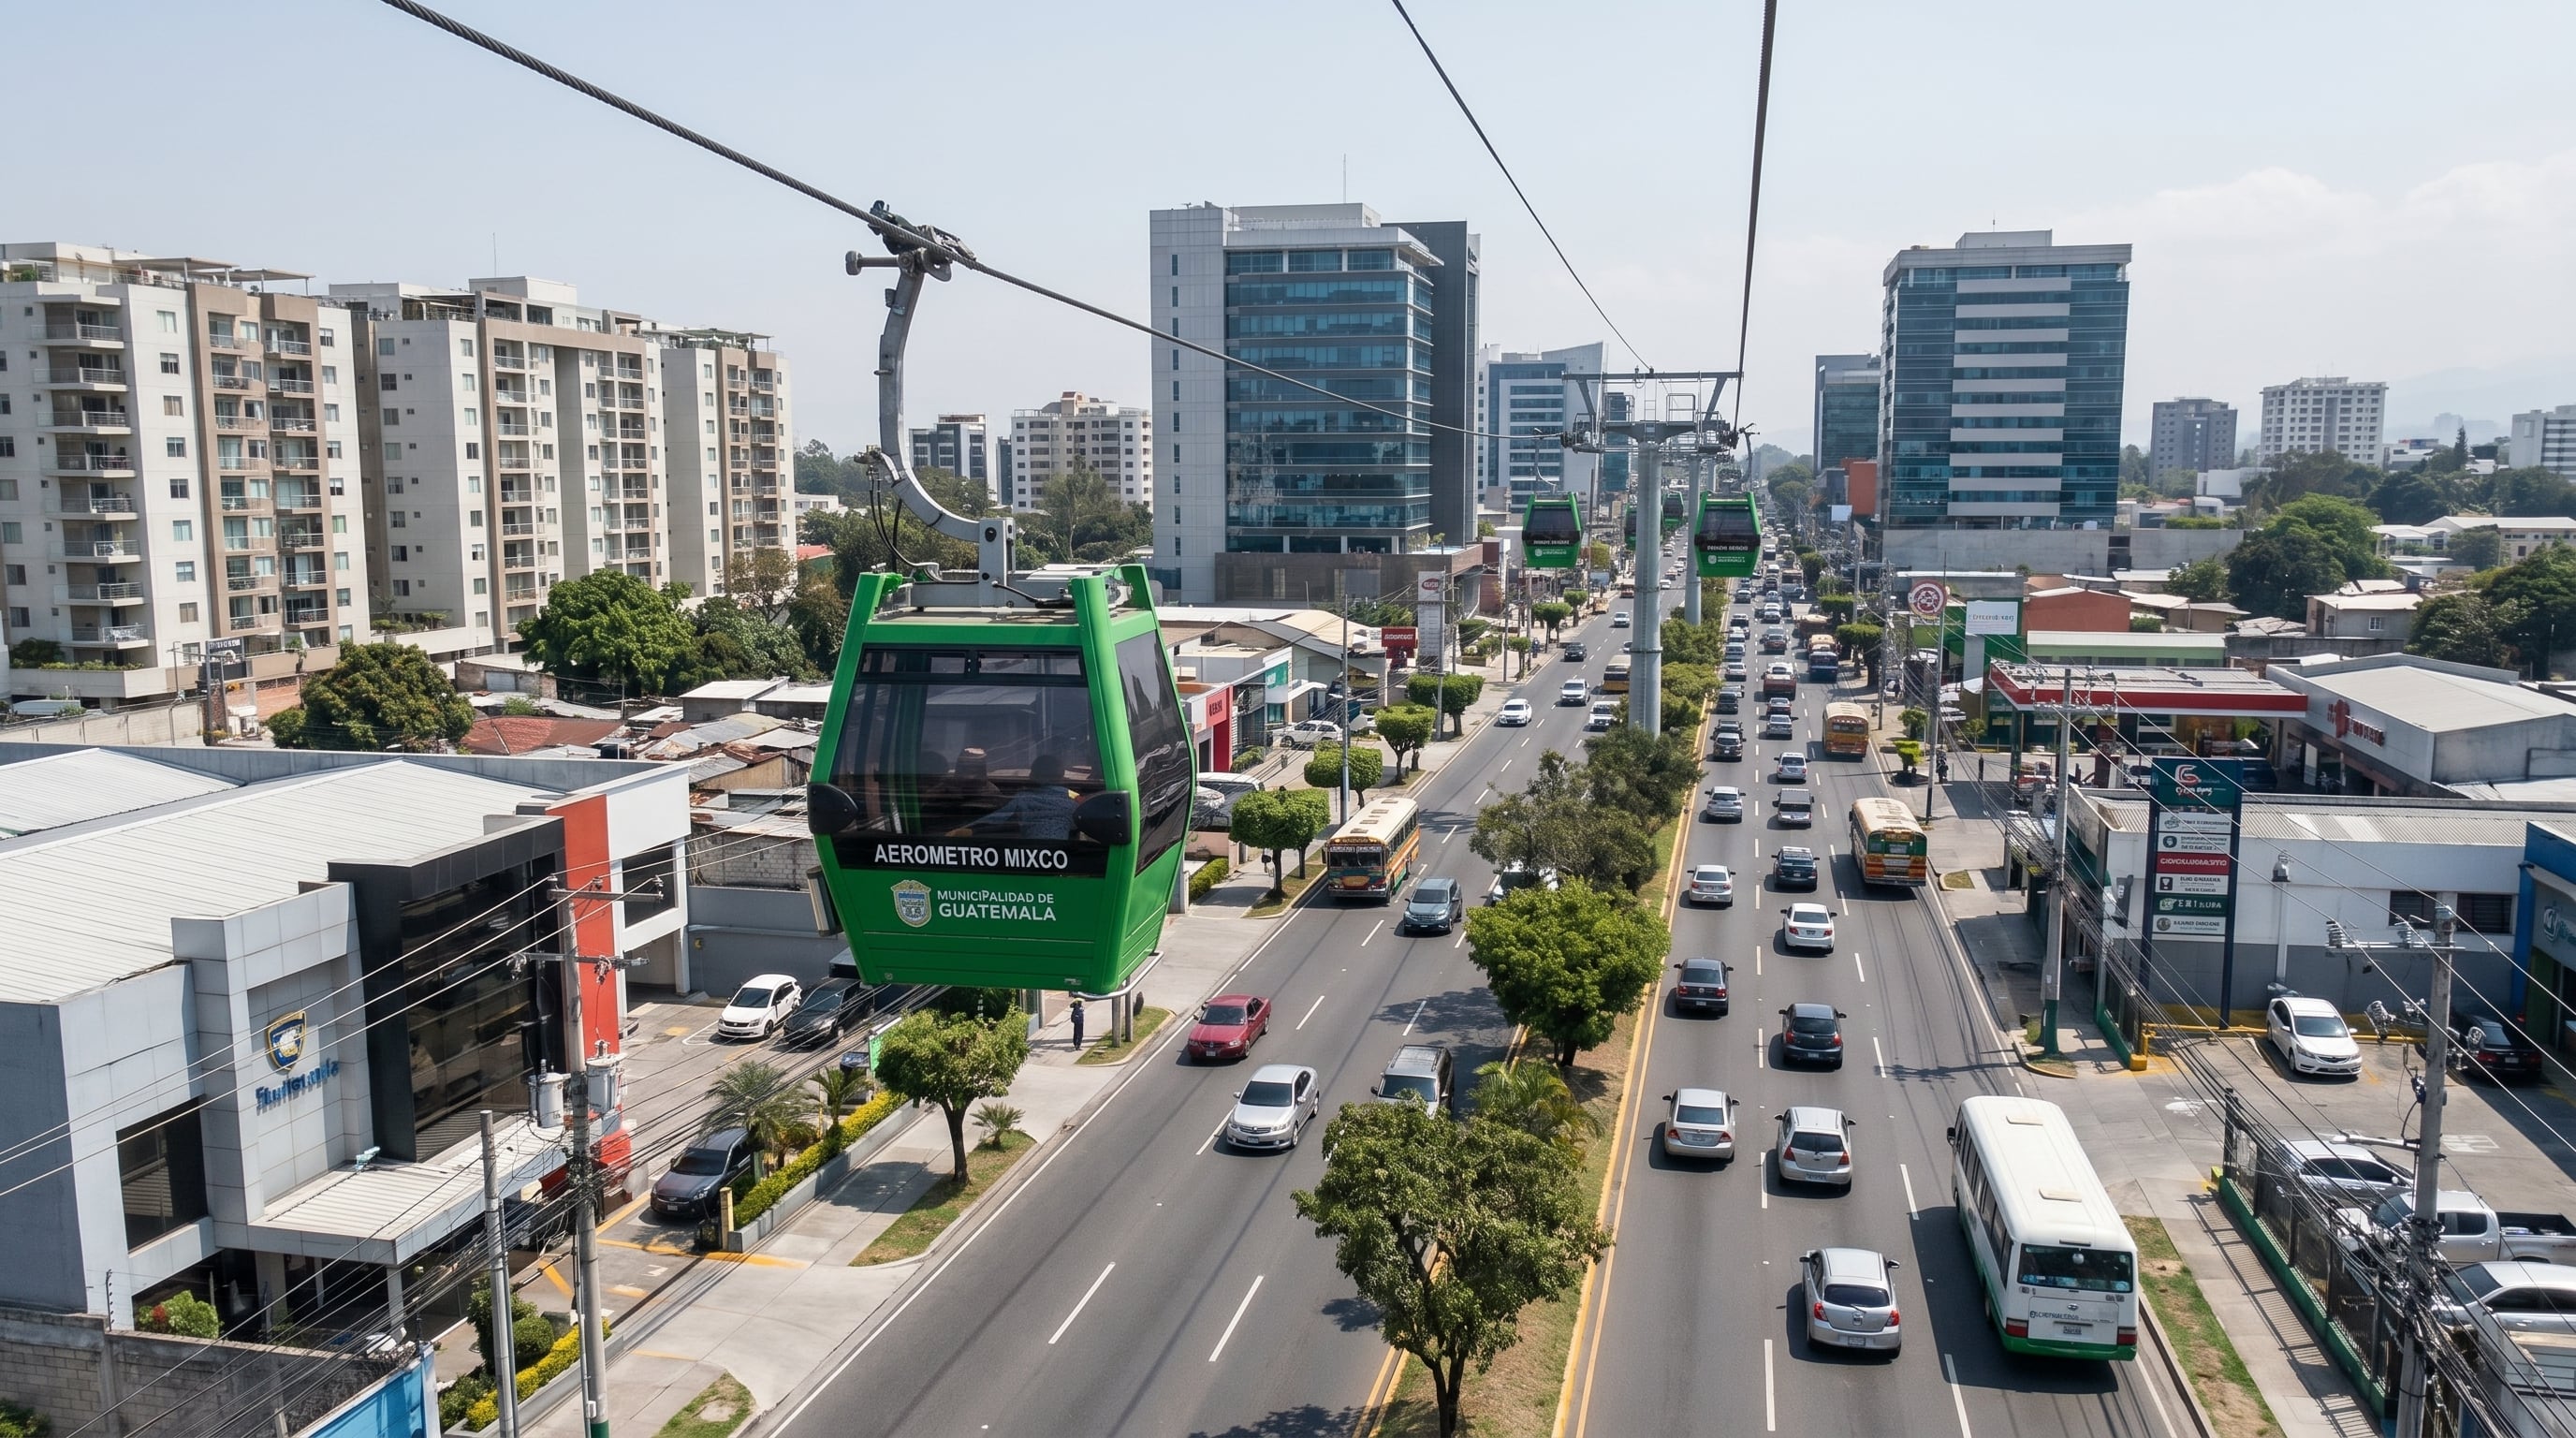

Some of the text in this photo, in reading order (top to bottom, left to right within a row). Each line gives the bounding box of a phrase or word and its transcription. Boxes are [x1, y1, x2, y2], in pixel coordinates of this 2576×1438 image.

[875, 844, 1068, 869] AEROMETRO MIXCO
[937, 889, 1034, 903] MUNICIPALIDAD
[1038, 893, 1054, 903] DE
[939, 904, 1056, 921] GUATEMALA
